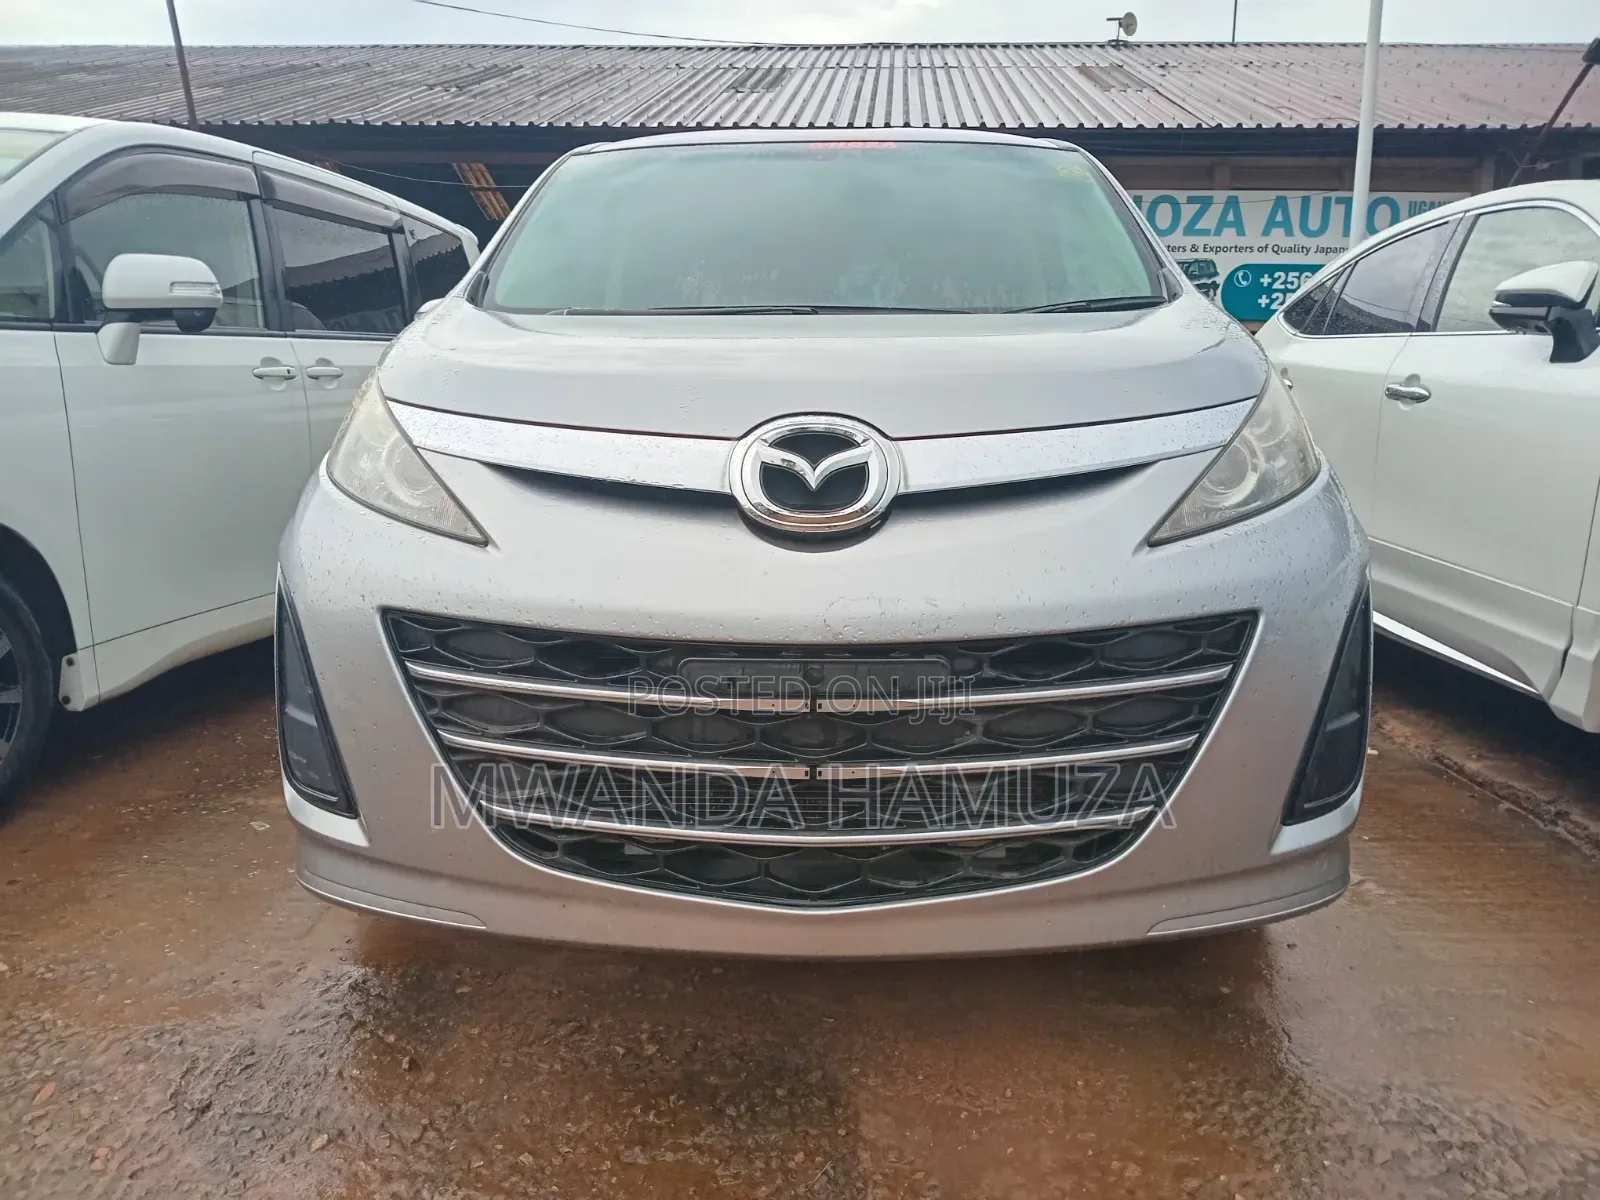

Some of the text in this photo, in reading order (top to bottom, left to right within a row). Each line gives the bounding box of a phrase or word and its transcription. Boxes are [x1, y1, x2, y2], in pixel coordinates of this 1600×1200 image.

[1133, 194, 1400, 238] OZA AUTO
[1190, 243, 1199, 253] &
[1203, 243, 1254, 255] Exporters
[1257, 243, 1269, 253] of
[1271, 243, 1311, 255] Quality
